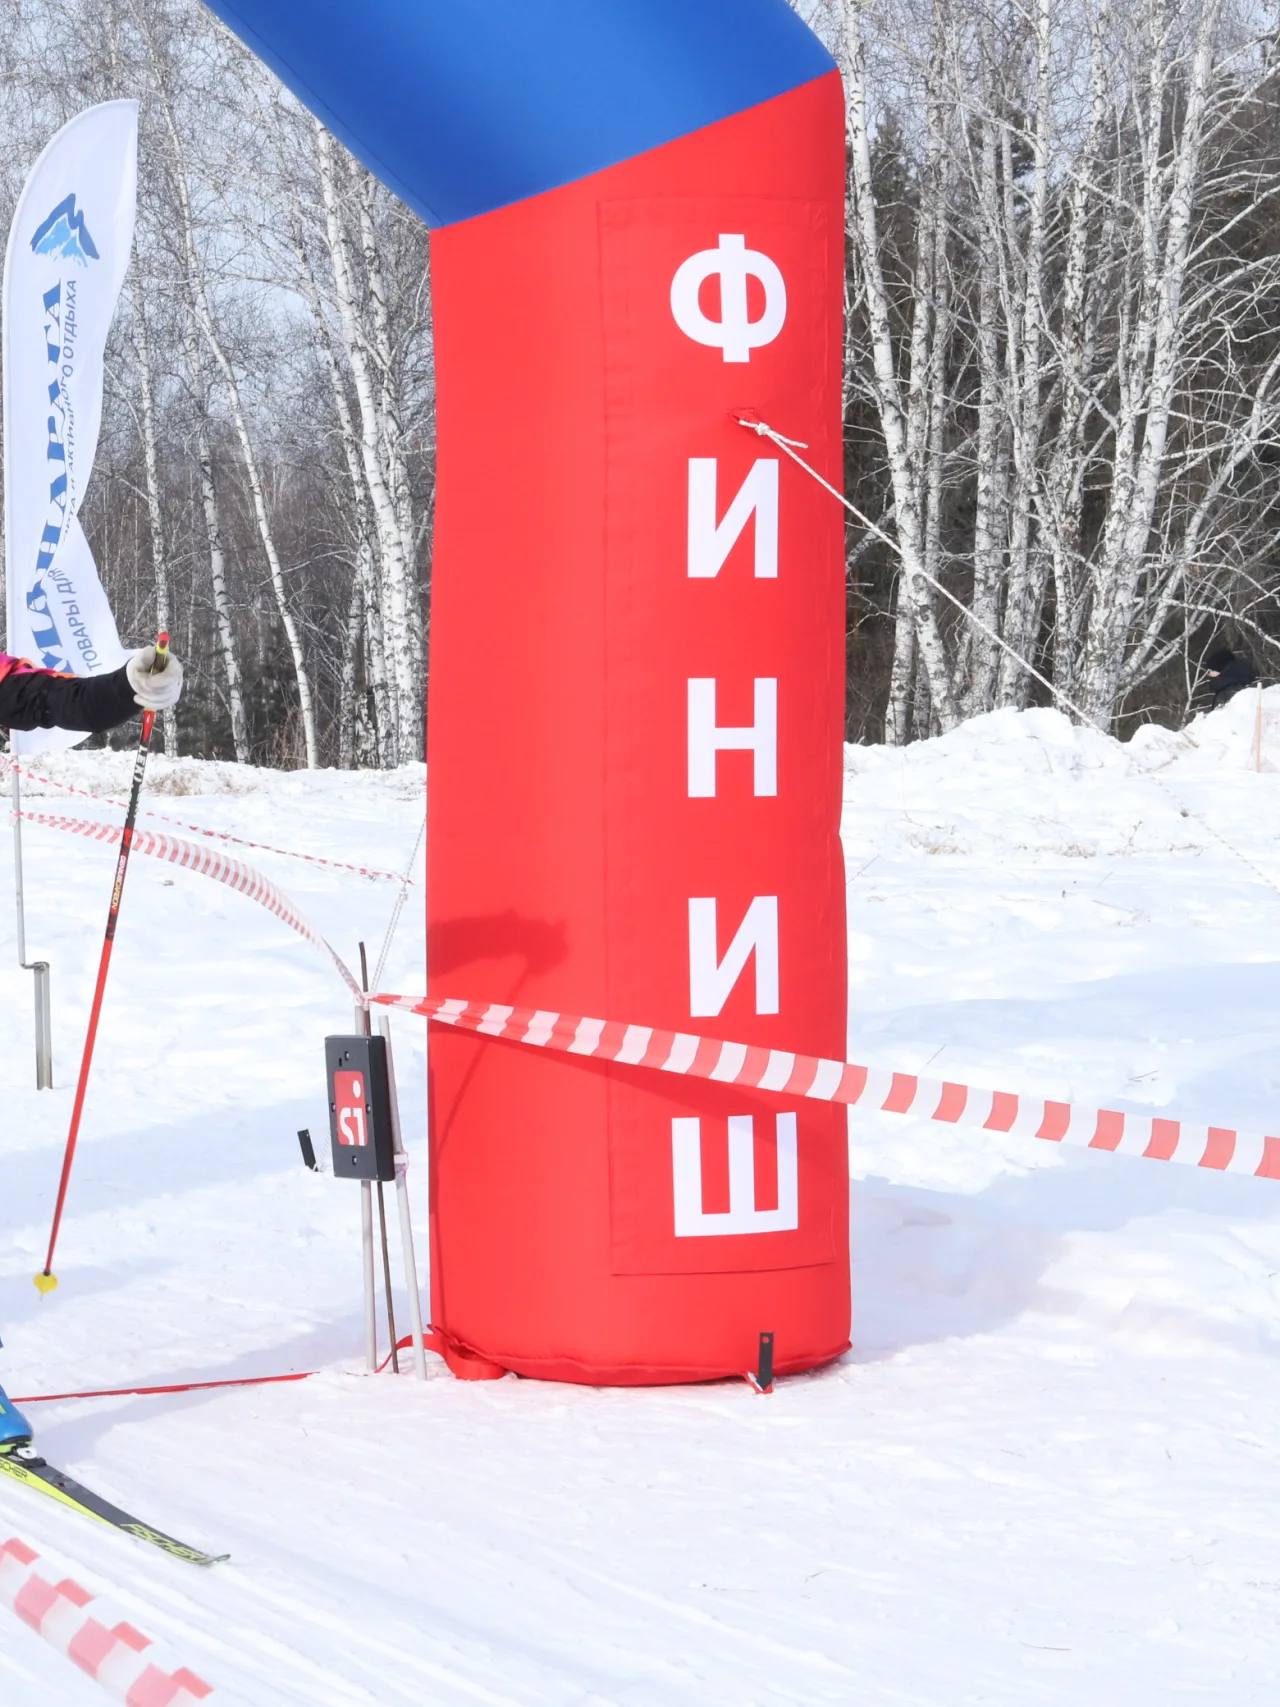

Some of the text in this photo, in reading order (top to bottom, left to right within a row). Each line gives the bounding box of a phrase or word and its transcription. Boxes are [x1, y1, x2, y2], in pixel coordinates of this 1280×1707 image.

[62, 279, 78, 359] ОТДЫХА
[60, 364, 76, 473] АКТИВНОГО
[47, 567, 77, 594] ДЛЯ
[61, 600, 102, 671] ТОВАРЫ
[133, 746, 148, 783] LEKI
[670, 233, 799, 1238] ФИНИШ
[120, 1523, 207, 1562] FISCHER
